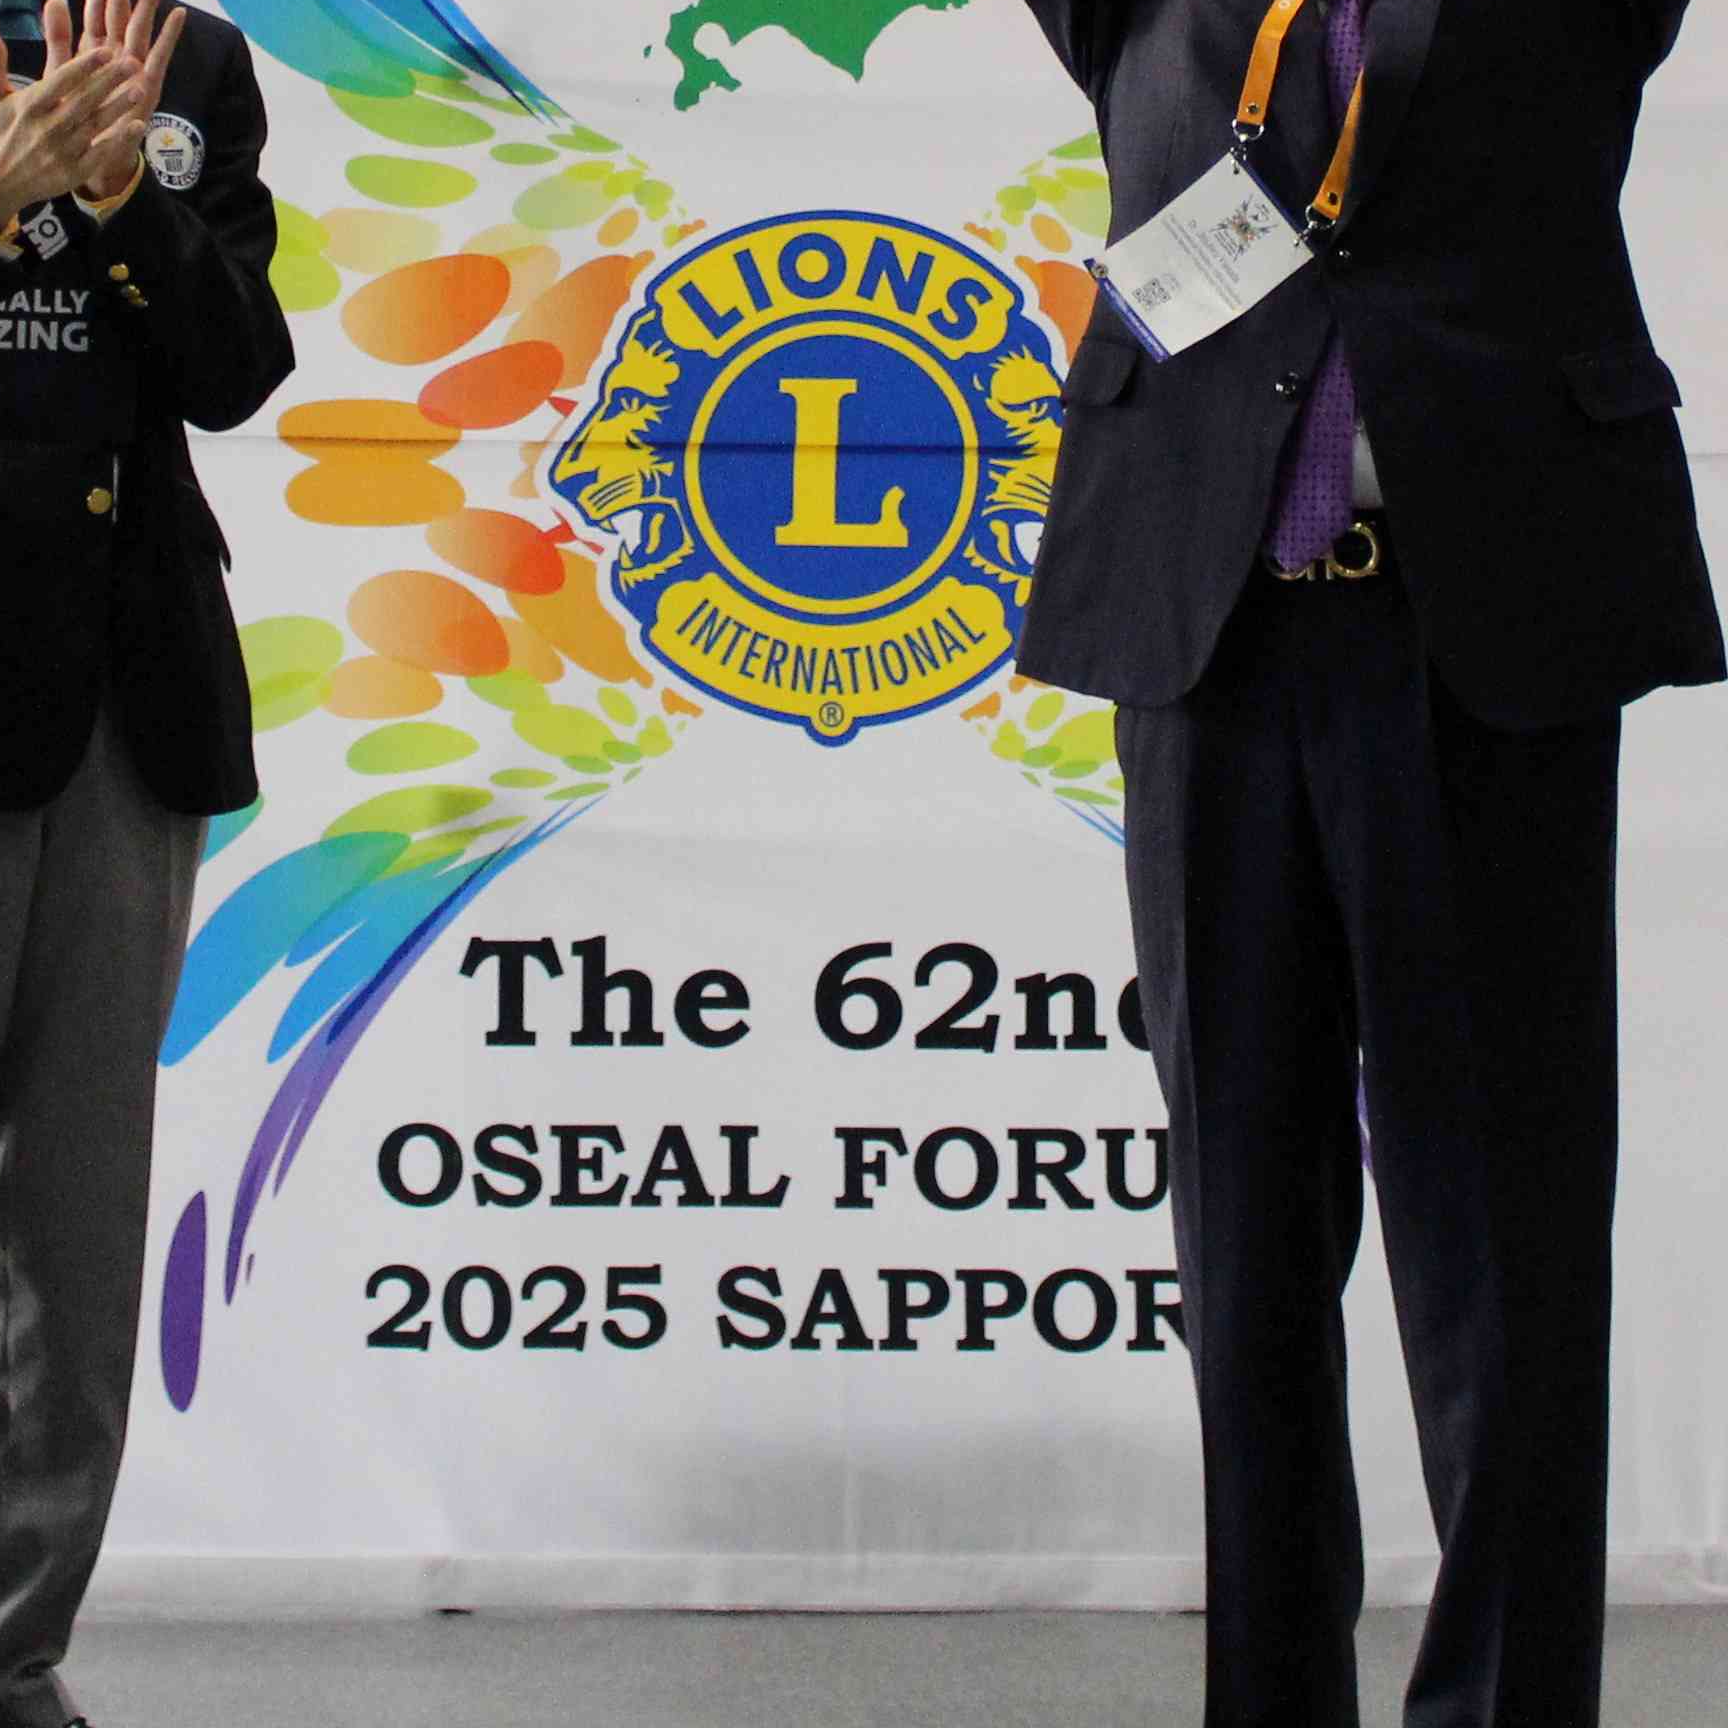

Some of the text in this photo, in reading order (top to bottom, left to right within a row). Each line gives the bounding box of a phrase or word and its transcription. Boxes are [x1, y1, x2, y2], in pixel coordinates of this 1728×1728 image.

[678, 231, 994, 342] LIONS
[774, 378, 909, 548] L
[675, 597, 987, 695] INTERNATIONAL
[458, 935, 752, 1050] The
[377, 1121, 1171, 1212] OSEAL FORU
[364, 1264, 1190, 1354] 2025 SAPPOR
